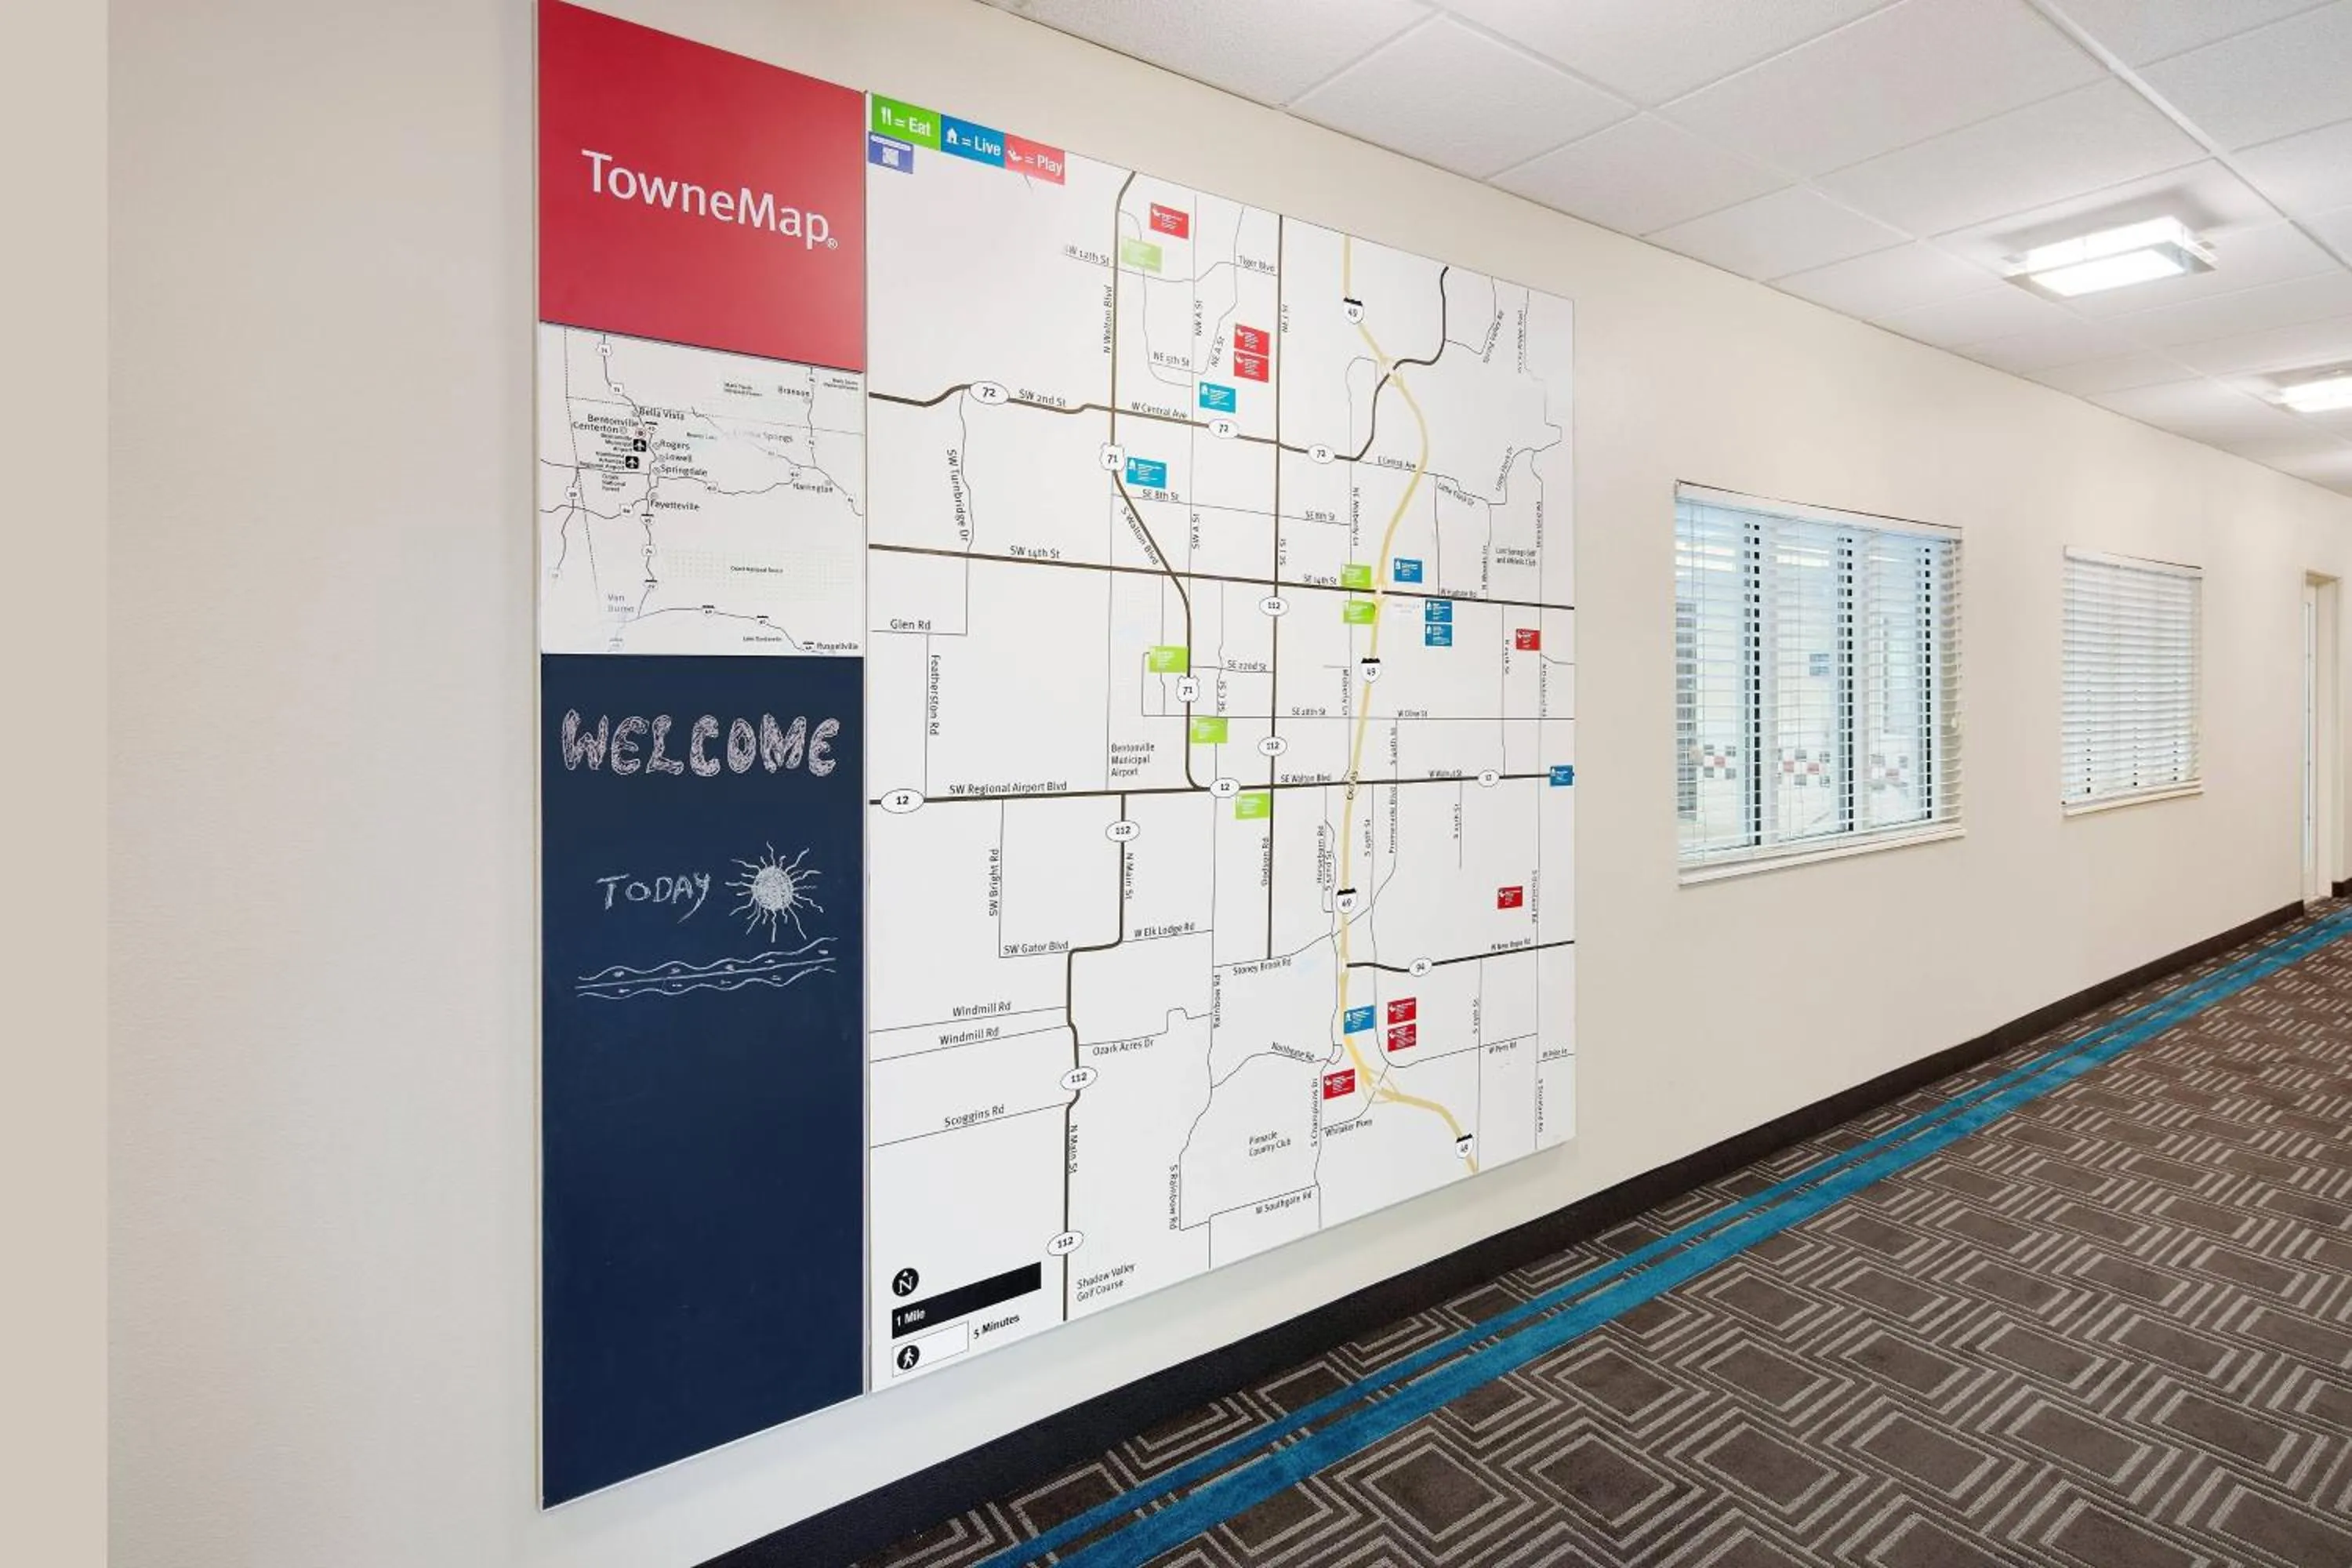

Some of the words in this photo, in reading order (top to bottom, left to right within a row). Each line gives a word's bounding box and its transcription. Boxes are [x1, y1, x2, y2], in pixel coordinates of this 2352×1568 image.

[909, 117, 931, 137] Eat
[975, 136, 1001, 156] Live
[1037, 154, 1063, 176] Play
[1104, 285, 1113, 309] Blvd
[1104, 310, 1113, 345] Walton
[982, 387, 996, 397] 72
[1019, 389, 1035, 401] SW
[1036, 392, 1054, 405] 2nd
[1055, 395, 1066, 407] St
[1131, 401, 1141, 411] W
[946, 448, 959, 468] SW
[1107, 454, 1118, 464] 71
[1010, 545, 1026, 557] SW
[1027, 547, 1048, 561] 14th
[1049, 548, 1060, 560] St
[1268, 601, 1281, 610] 112
[890, 619, 915, 630] Glen
[918, 619, 931, 630] Rd
[930, 654, 941, 719] Featherston
[930, 722, 939, 736] Rd
[561, 709, 840, 777] WELCOME
[1112, 743, 1155, 753] Bentonville
[1266, 742, 1279, 750] 112
[1111, 754, 1150, 767] Municipal
[1111, 767, 1138, 778] Airport
[949, 784, 966, 795] SW
[968, 782, 1011, 797] Regional
[1012, 782, 1046, 795] Airport
[1047, 781, 1068, 792] Blvd
[1221, 782, 1230, 791] 12
[897, 795, 909, 805] 12
[1116, 826, 1131, 836] 112
[989, 849, 999, 862] Rd
[989, 865, 1001, 898] Bright
[594, 872, 711, 924] TODAY
[989, 900, 998, 916] SW
[1144, 927, 1156, 937] Elk
[1004, 944, 1019, 955] SW
[1022, 942, 1047, 953] Gator
[1048, 940, 1069, 951] Blvd
[953, 1003, 996, 1017] Windmill
[998, 1000, 1011, 1011] Rd
[940, 1030, 984, 1045] Windmill
[985, 1026, 1000, 1037] Rd
[1093, 1043, 1117, 1056] Ozark
[1120, 1040, 1142, 1053] Acres
[1142, 1038, 1155, 1049] Dr
[1071, 1072, 1087, 1083] 112
[945, 1109, 989, 1128] Scoggins
[992, 1104, 1005, 1115] Rd
[1069, 1135, 1078, 1160] Main
[1069, 1163, 1078, 1174] St
[1057, 1236, 1073, 1249] 112
[1076, 1271, 1110, 1290] Shadow
[1110, 1262, 1136, 1279] Valley
[905, 1309, 926, 1324] Mile
[973, 1327, 980, 1340] 5
[982, 1314, 1020, 1334] Minutes
